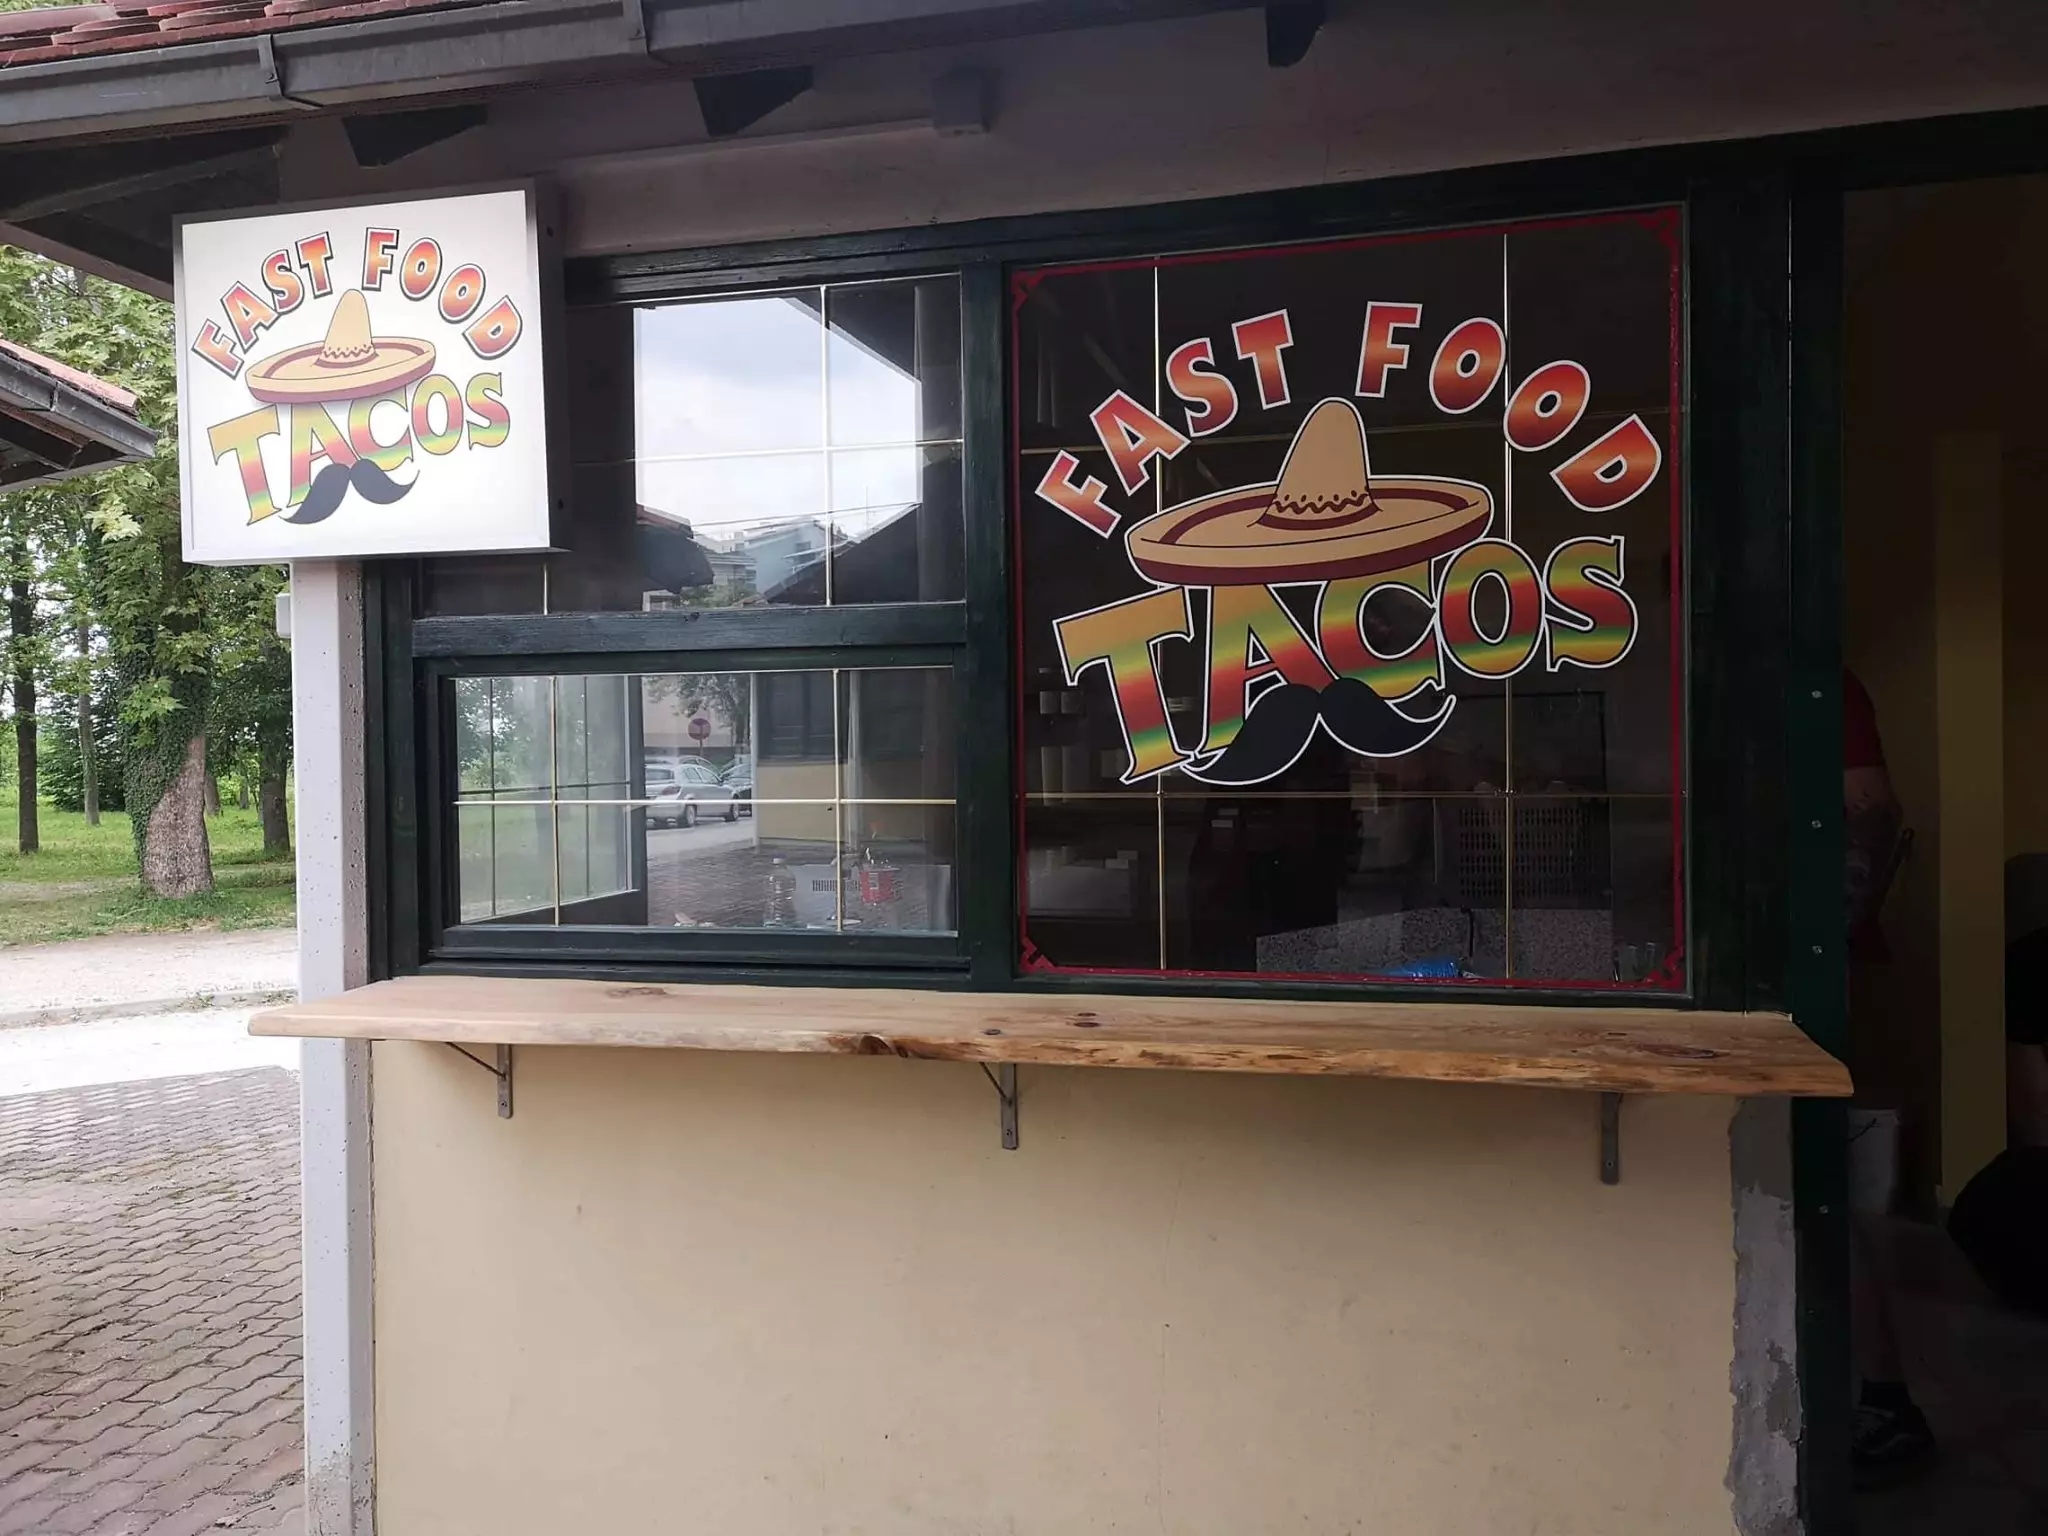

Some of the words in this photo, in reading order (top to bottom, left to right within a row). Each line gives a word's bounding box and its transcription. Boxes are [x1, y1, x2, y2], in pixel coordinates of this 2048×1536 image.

[192, 231, 333, 379] FAST
[361, 227, 523, 360] FOOD
[207, 372, 511, 525] TACOS
[1035, 308, 1294, 538] FAST
[1354, 301, 1662, 511] FOOD
[1053, 535, 1638, 784] TACOS
